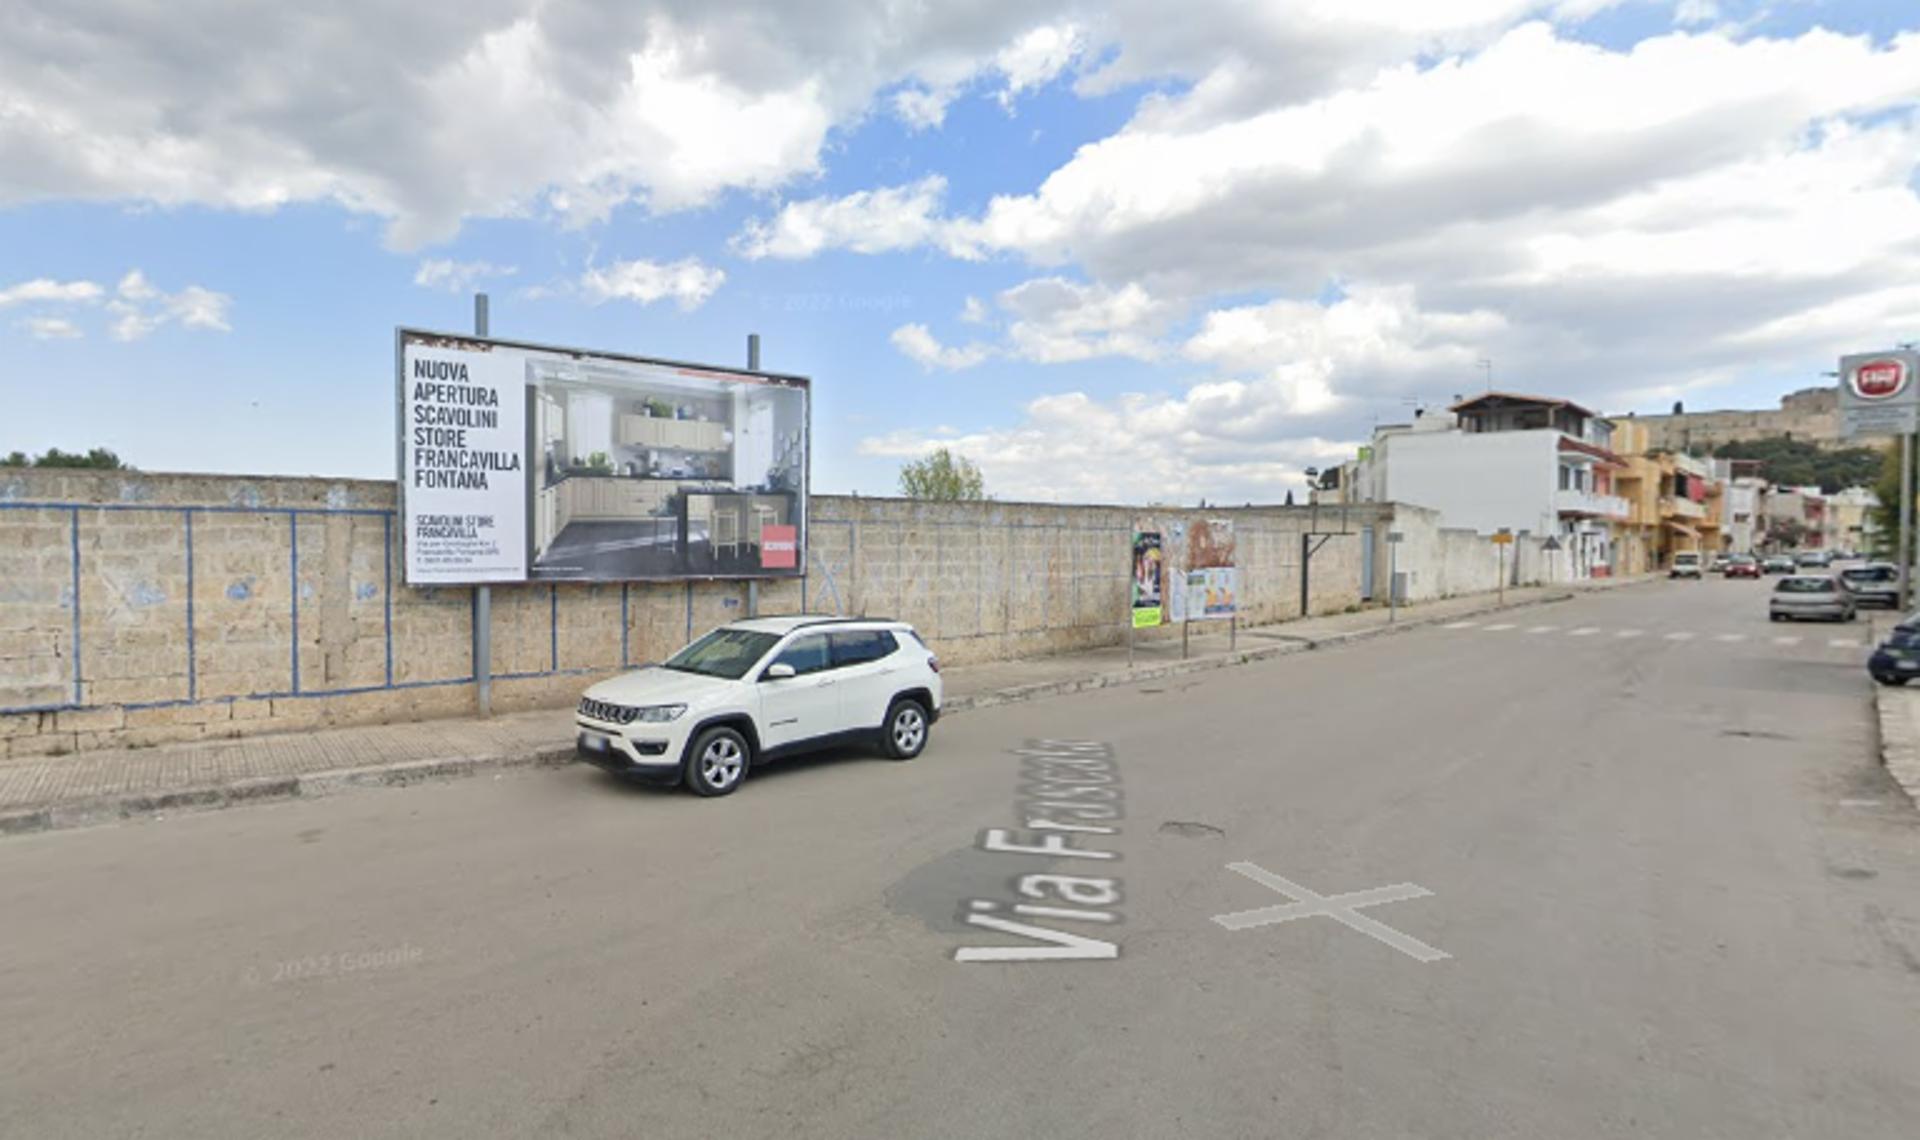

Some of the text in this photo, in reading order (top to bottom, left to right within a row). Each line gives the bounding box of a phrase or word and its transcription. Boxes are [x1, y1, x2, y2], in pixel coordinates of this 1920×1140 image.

[414, 359, 469, 382] NUOVA
[414, 382, 499, 407] APERTURA
[414, 404, 498, 428] SCAVOLINI
[414, 427, 467, 448] STORE
[414, 448, 520, 471] FRANCAVILLA
[414, 469, 488, 490] FONTANA
[416, 514, 495, 528] SCAVOLINI STORE
[416, 526, 478, 538] FRANCAVILLA
